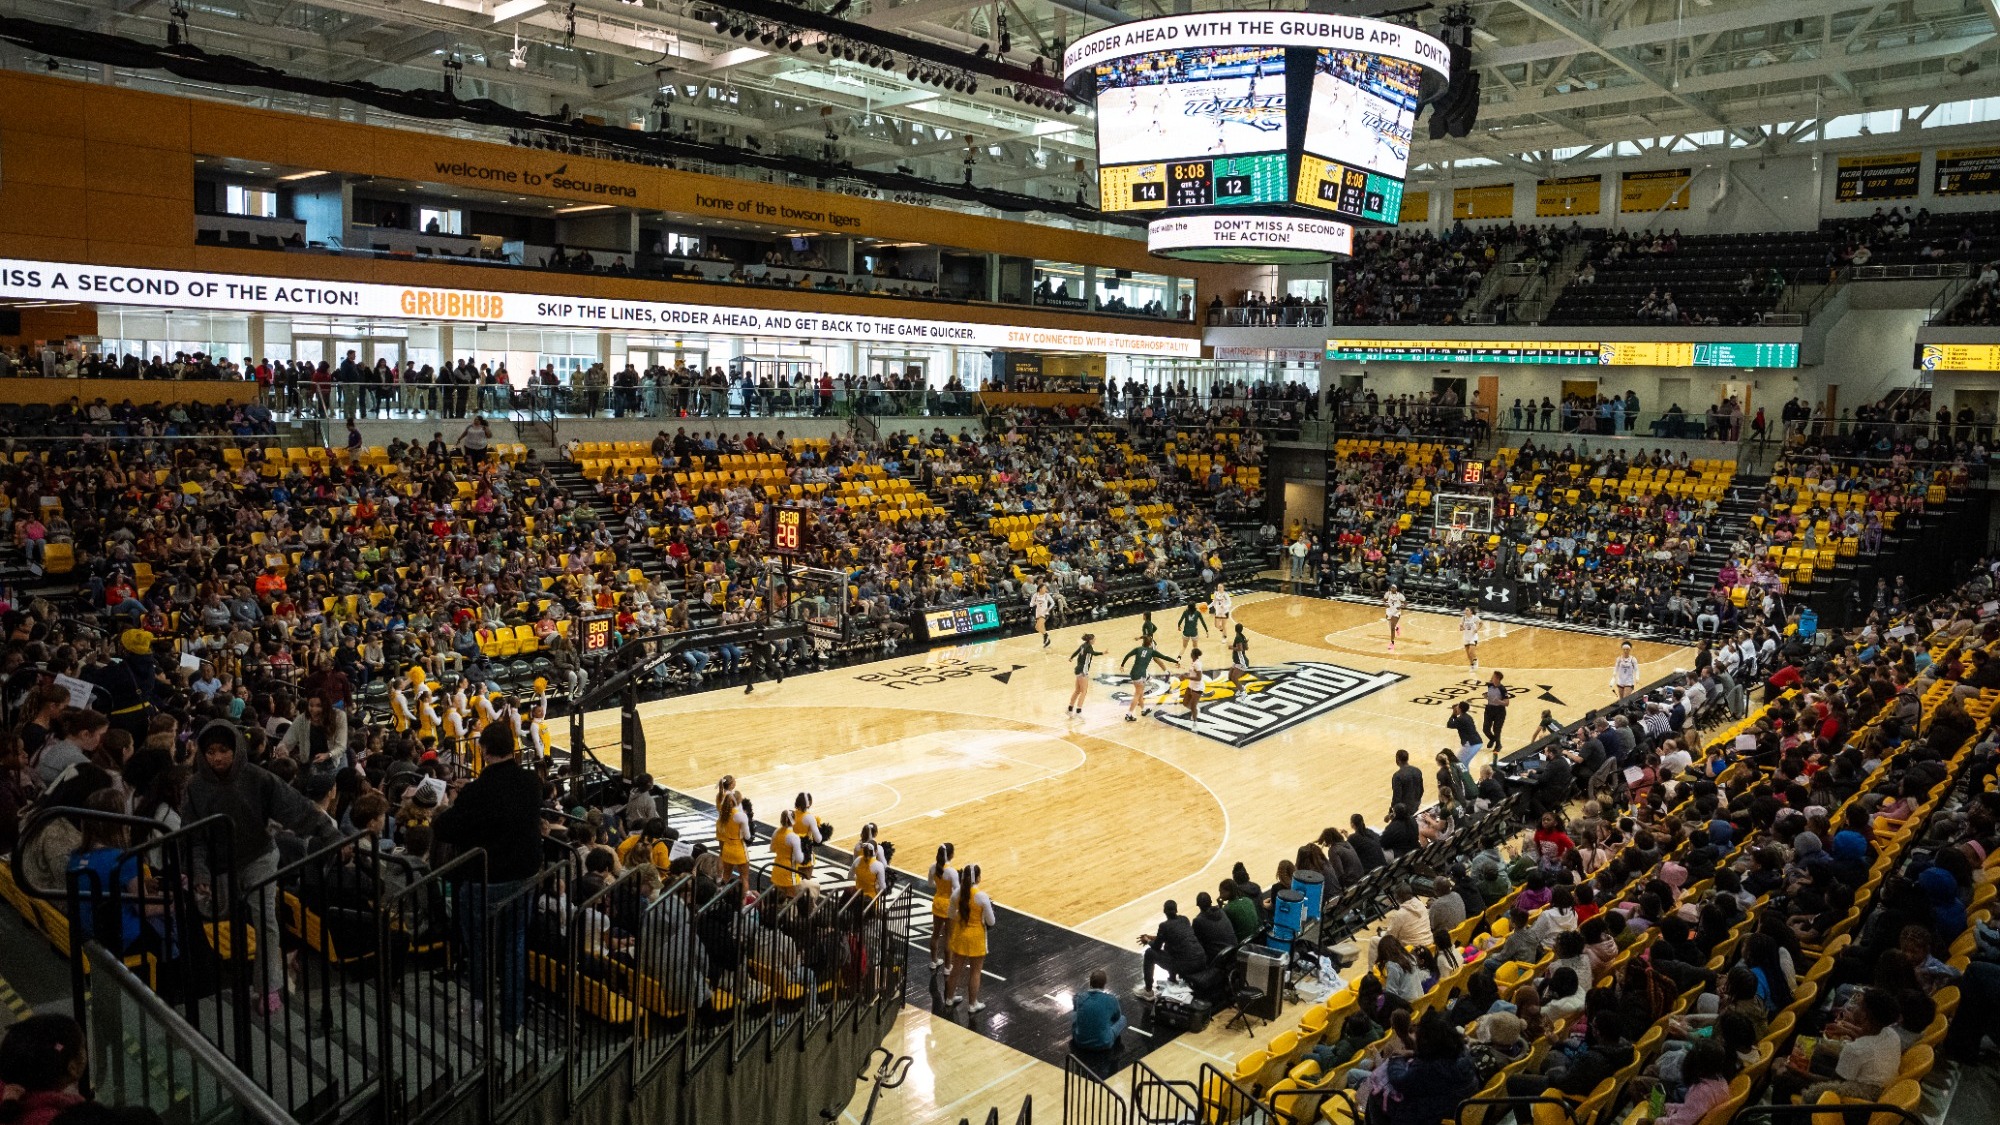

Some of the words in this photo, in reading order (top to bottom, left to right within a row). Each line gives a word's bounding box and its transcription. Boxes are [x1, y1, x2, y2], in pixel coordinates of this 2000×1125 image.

[1084, 35, 1121, 57] ORDER
[1125, 26, 1179, 46] AHEAD
[1184, 21, 1232, 37] WITH
[1238, 21, 1274, 35] THE
[1280, 21, 1365, 40] GRUBHUB
[1369, 29, 1401, 48] APP!
[435, 162, 517, 183] welcome
[523, 170, 542, 187] to
[552, 176, 591, 192] secu
[594, 182, 636, 198] arena
[1174, 164, 1205, 181] 8:08
[1346, 171, 1364, 188] 8:08
[1840, 170, 1862, 178] NCAA
[1863, 167, 1917, 177] TOURNAMENT
[1141, 185, 1157, 200] 14
[1226, 180, 1242, 195] 12
[1323, 184, 1334, 199] 14
[696, 193, 733, 210] home
[738, 200, 753, 212] of
[756, 201, 777, 215] the
[781, 205, 825, 222] towson
[829, 212, 861, 227] tigers
[1371, 196, 1380, 210] 12
[1175, 222, 1188, 231] the
[1214, 220, 1251, 230] DON'T
[1255, 221, 1283, 231] MISS
[1284, 223, 1294, 232] A
[1297, 223, 1335, 236] SECOND
[1214, 232, 1236, 241] THE
[1240, 232, 1290, 242] ACTION!
[51, 273, 69, 289] A
[78, 274, 179, 296] SECOND
[188, 281, 218, 298] OF
[226, 283, 267, 300] THE
[274, 286, 359, 306] ACTION!
[400, 290, 503, 319] GRUBHUB
[537, 303, 573, 317] SKIP
[577, 305, 606, 318] THE
[611, 307, 656, 324] LINES,
[661, 310, 708, 325] ORDER
[713, 313, 761, 330] AHEAD,
[765, 316, 792, 329] AND
[795, 318, 818, 331] GET
[822, 319, 853, 333] BACK
[856, 322, 871, 334] TO
[874, 323, 895, 335] THE
[898, 324, 927, 337] GAME
[930, 326, 976, 340] QUICKER.
[1008, 331, 1031, 342] STAY
[1033, 333, 1084, 346] CONNECTED
[1086, 336, 1106, 347] WITH
[1464, 469, 1480, 482] 28
[780, 511, 799, 524] 8:08
[777, 524, 797, 548] 28
[588, 620, 609, 632] 8:08
[941, 619, 952, 629] 14
[975, 613, 984, 623] 12
[588, 633, 606, 649] 28
[643, 651, 672, 671] Schelde
[881, 664, 998, 690] secu
[1158, 661, 1410, 748] TOWSON
